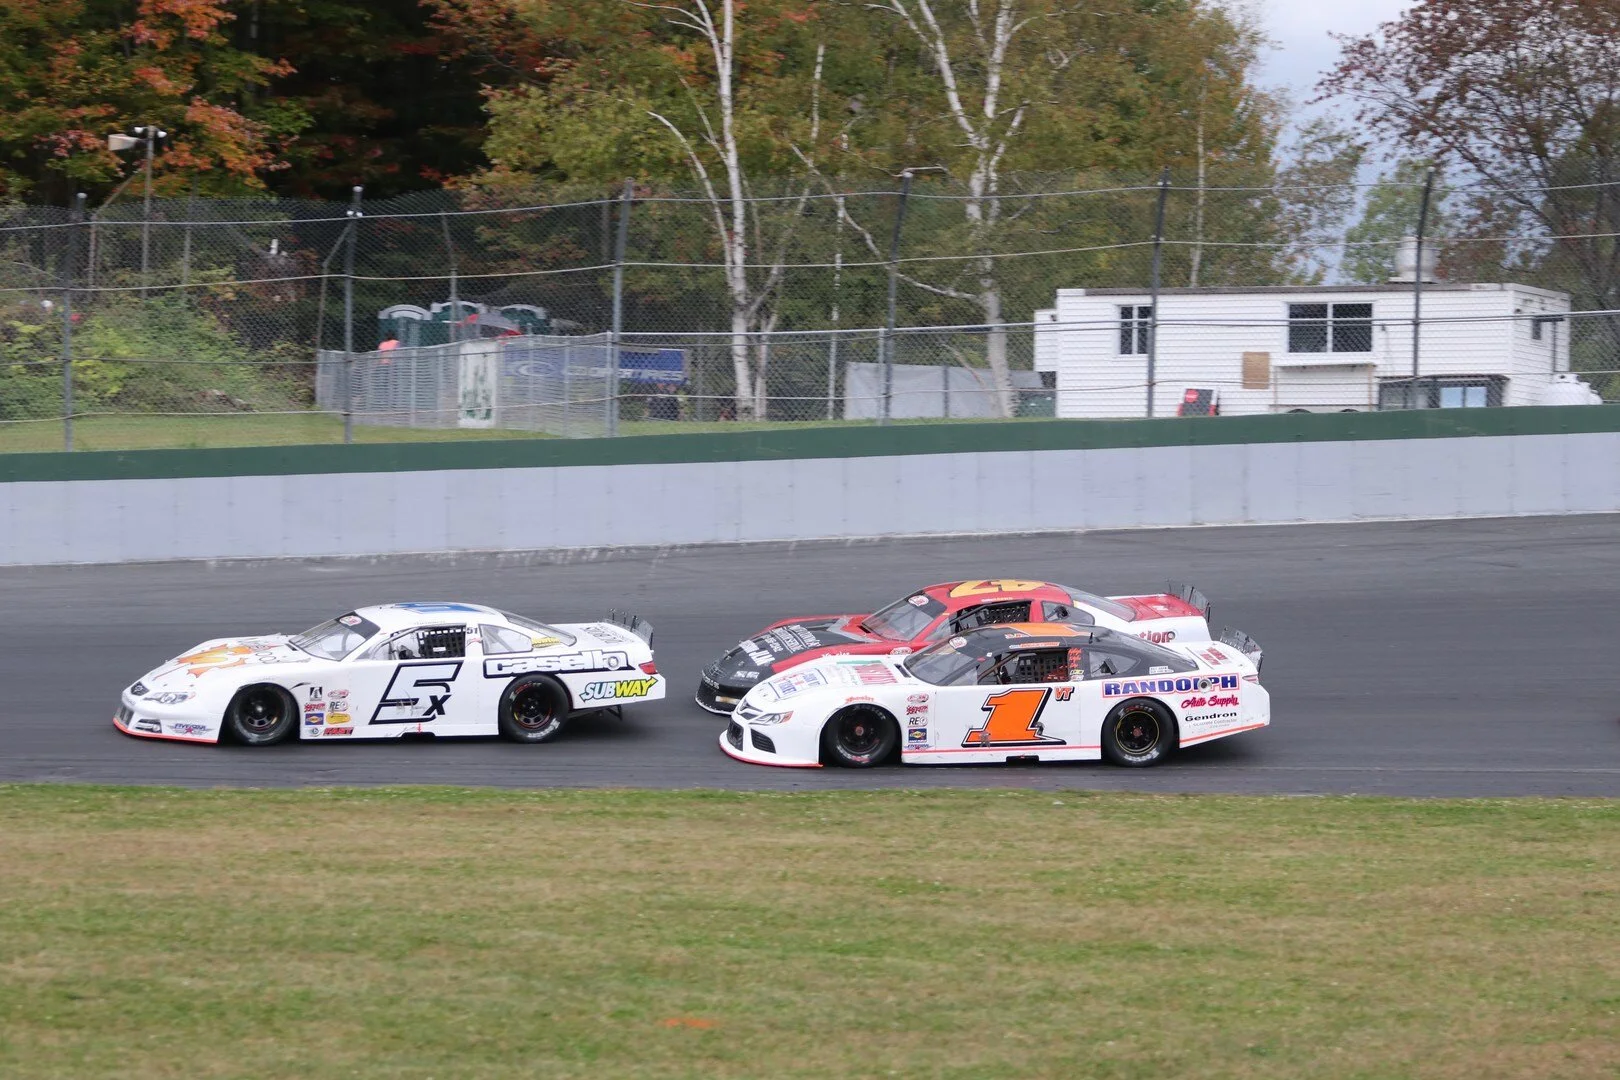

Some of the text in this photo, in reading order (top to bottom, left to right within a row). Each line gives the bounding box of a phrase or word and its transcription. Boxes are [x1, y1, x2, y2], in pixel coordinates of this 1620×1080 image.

[582, 677, 657, 701] SUBWAY
[1181, 695, 1239, 708] Auto Supply
[1185, 712, 1237, 722] Gendron
